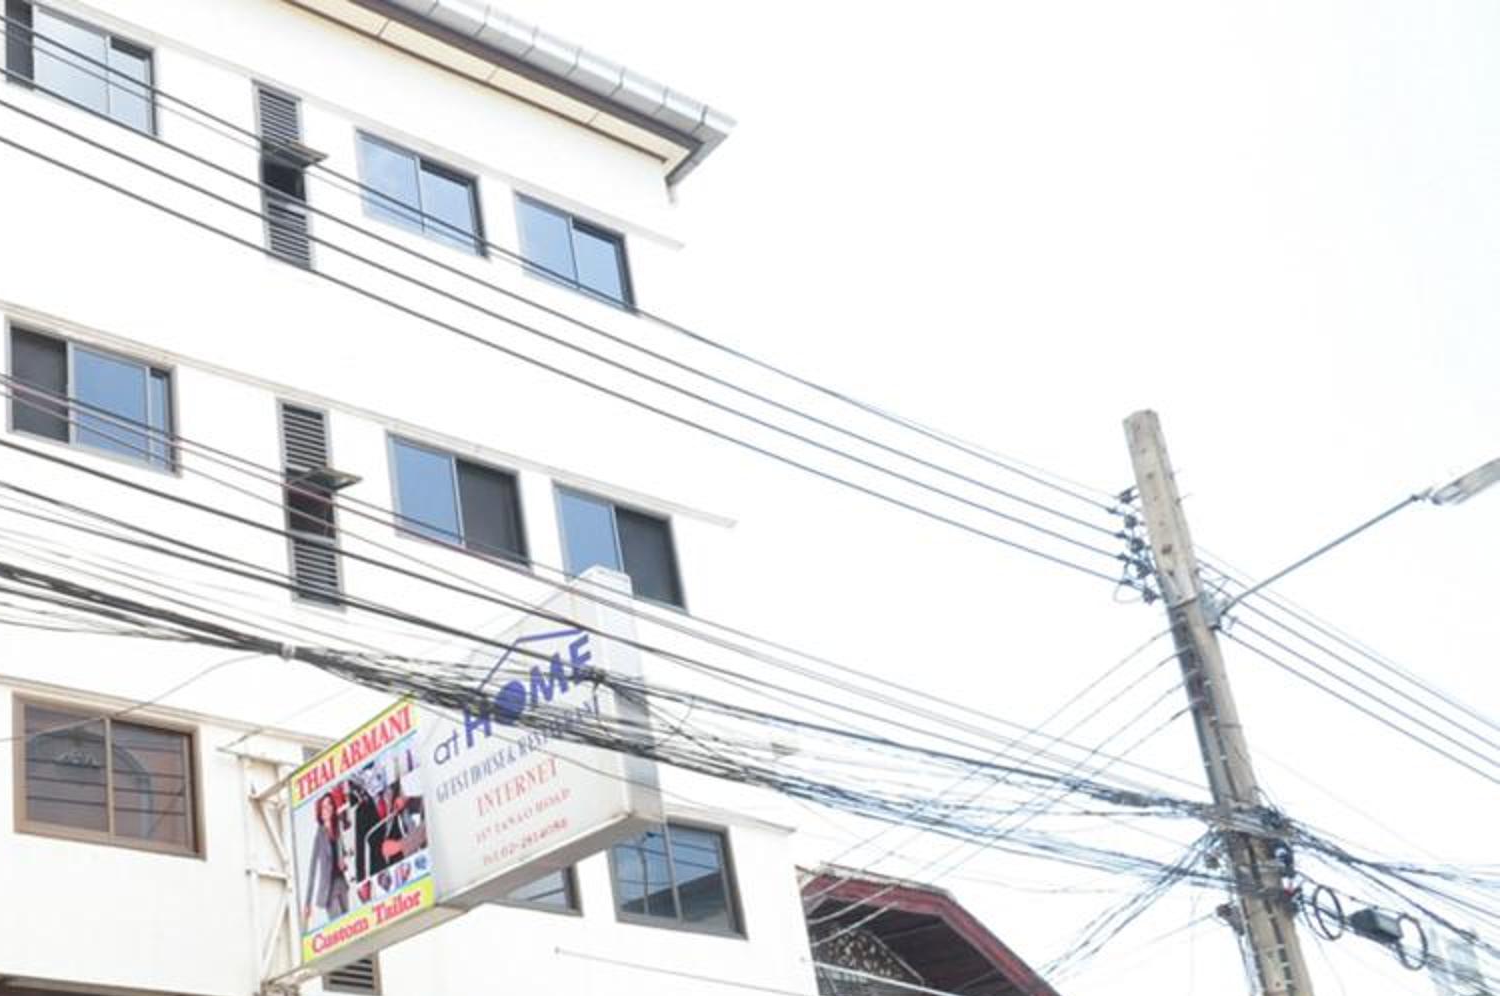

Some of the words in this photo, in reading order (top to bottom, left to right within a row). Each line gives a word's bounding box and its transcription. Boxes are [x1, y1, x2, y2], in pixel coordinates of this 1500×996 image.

[297, 755, 335, 800] THAI
[339, 704, 412, 771] ARMANI
[477, 757, 557, 817] INTERNET
[312, 917, 369, 955] Custom
[372, 889, 421, 926] Tailor
